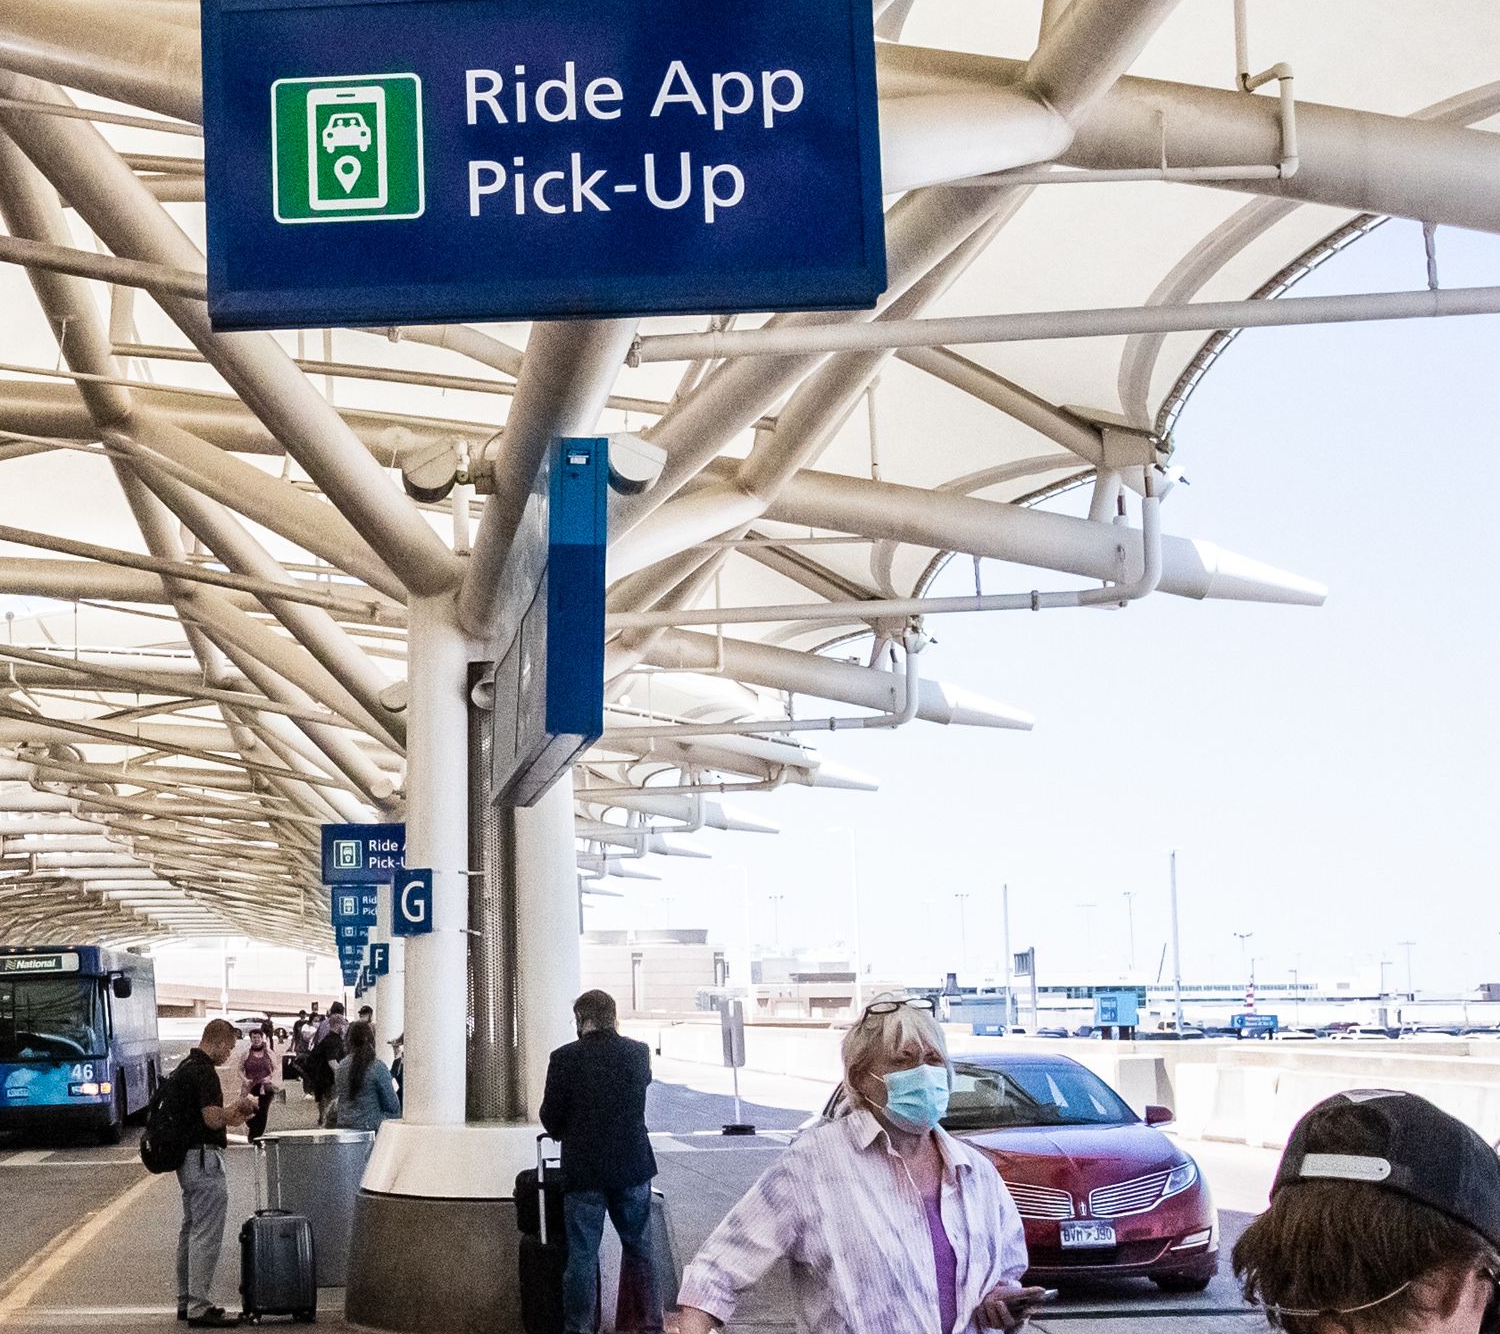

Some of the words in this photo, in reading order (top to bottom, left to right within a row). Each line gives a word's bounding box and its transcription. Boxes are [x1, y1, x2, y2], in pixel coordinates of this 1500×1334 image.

[465, 60, 624, 126] Ride
[649, 59, 805, 131] App
[468, 151, 746, 224] Pick-Up
[368, 838, 399, 852] Ride
[400, 880, 425, 923] G
[16, 958, 56, 970] National
[375, 948, 384, 969] F
[71, 1064, 93, 1080] 46
